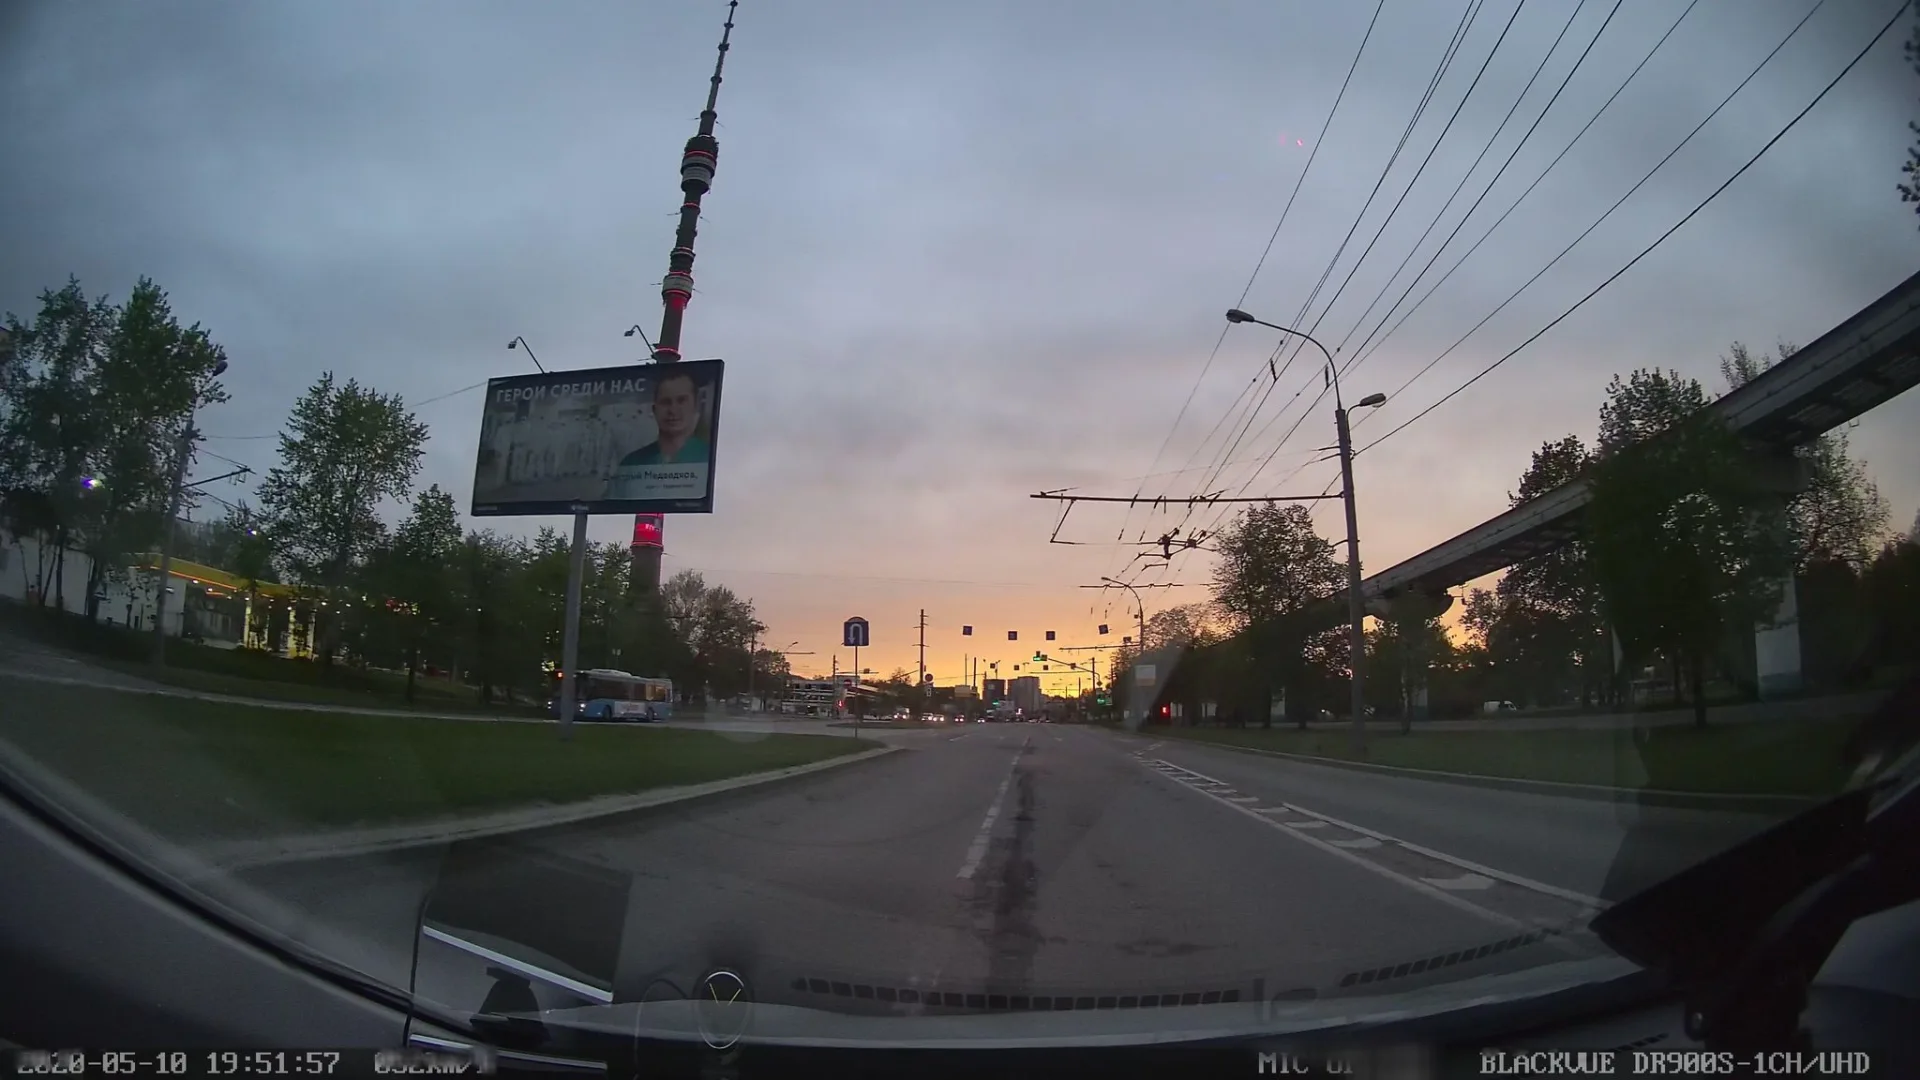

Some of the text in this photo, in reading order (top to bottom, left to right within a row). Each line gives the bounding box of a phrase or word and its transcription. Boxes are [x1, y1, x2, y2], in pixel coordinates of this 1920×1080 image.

[496, 377, 646, 403] ГЕРОИ СРЕДИ НАС
